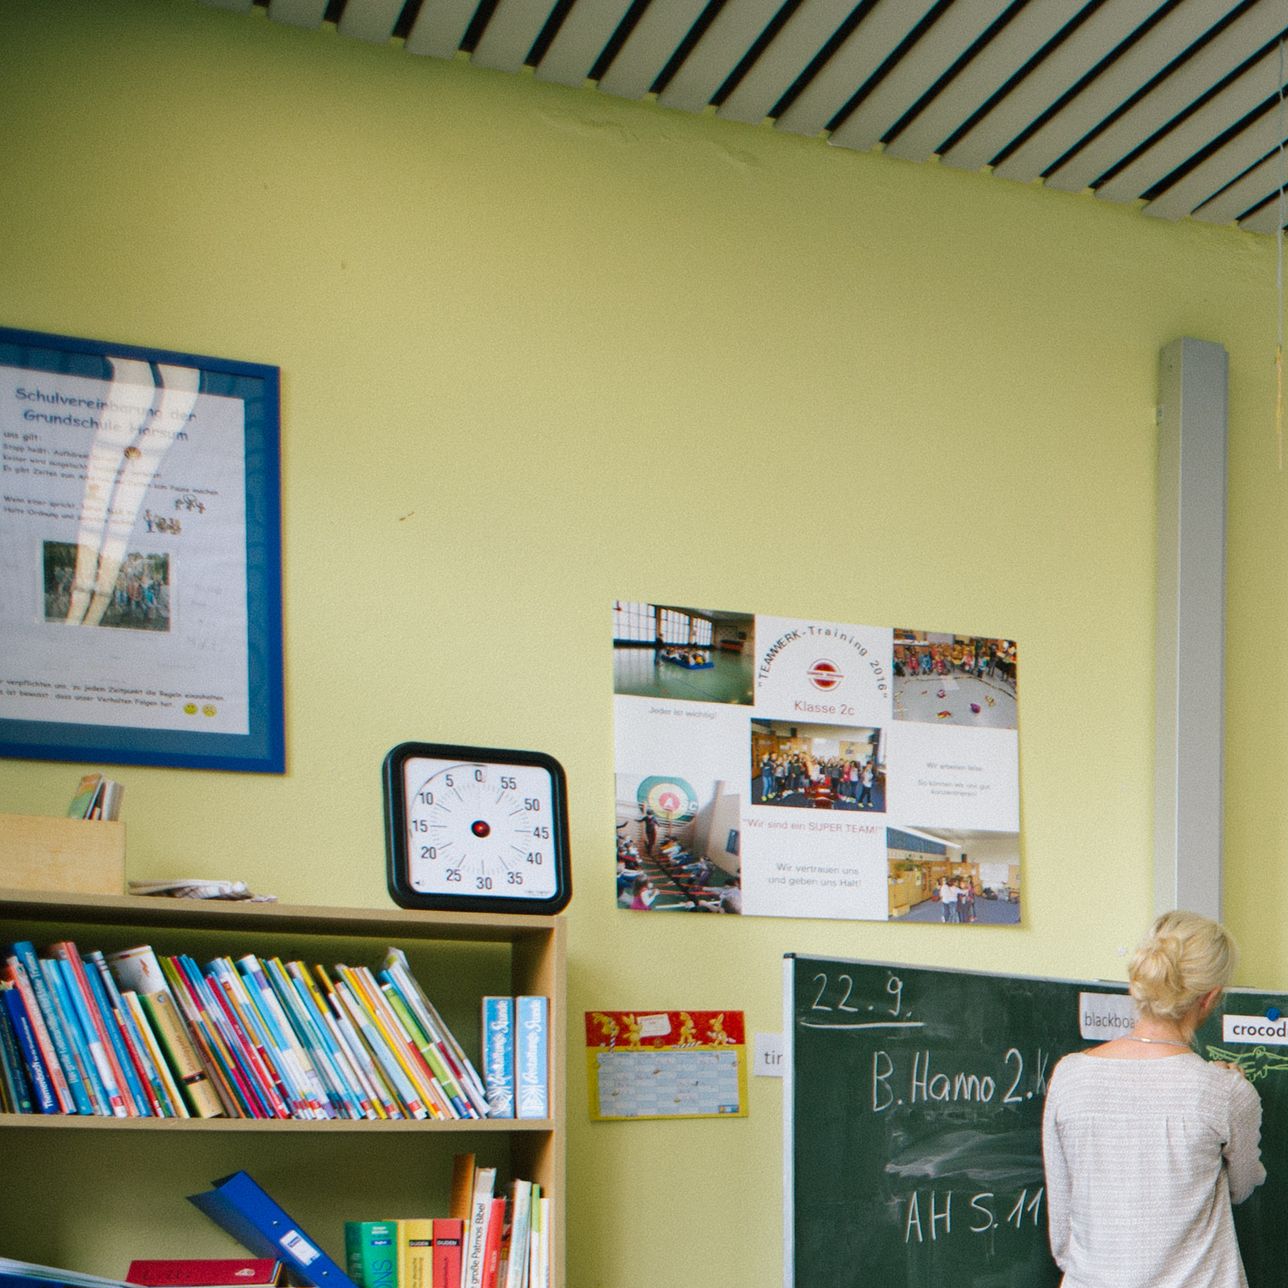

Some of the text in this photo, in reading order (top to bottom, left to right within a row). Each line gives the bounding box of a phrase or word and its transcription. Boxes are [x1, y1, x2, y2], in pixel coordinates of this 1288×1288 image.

[794, 700, 856, 716] Klasse 2c
[446, 774, 454, 788] 5
[475, 769, 483, 783] 0
[500, 777, 517, 790] 55
[419, 792, 434, 806] 10
[524, 798, 540, 812] 50
[412, 819, 429, 833] 15
[808, 822, 843, 833] SUPER
[533, 827, 550, 840] 45
[421, 846, 437, 860] 20
[526, 852, 543, 865] 40
[446, 868, 463, 882] 25
[507, 871, 524, 885] 35
[476, 876, 493, 890] 30
[474, 1202, 486, 1225] Bibel
[905, 1190, 952, 1244] AH
[470, 1226, 484, 1259] Patmos
[469, 1260, 482, 1286] große
